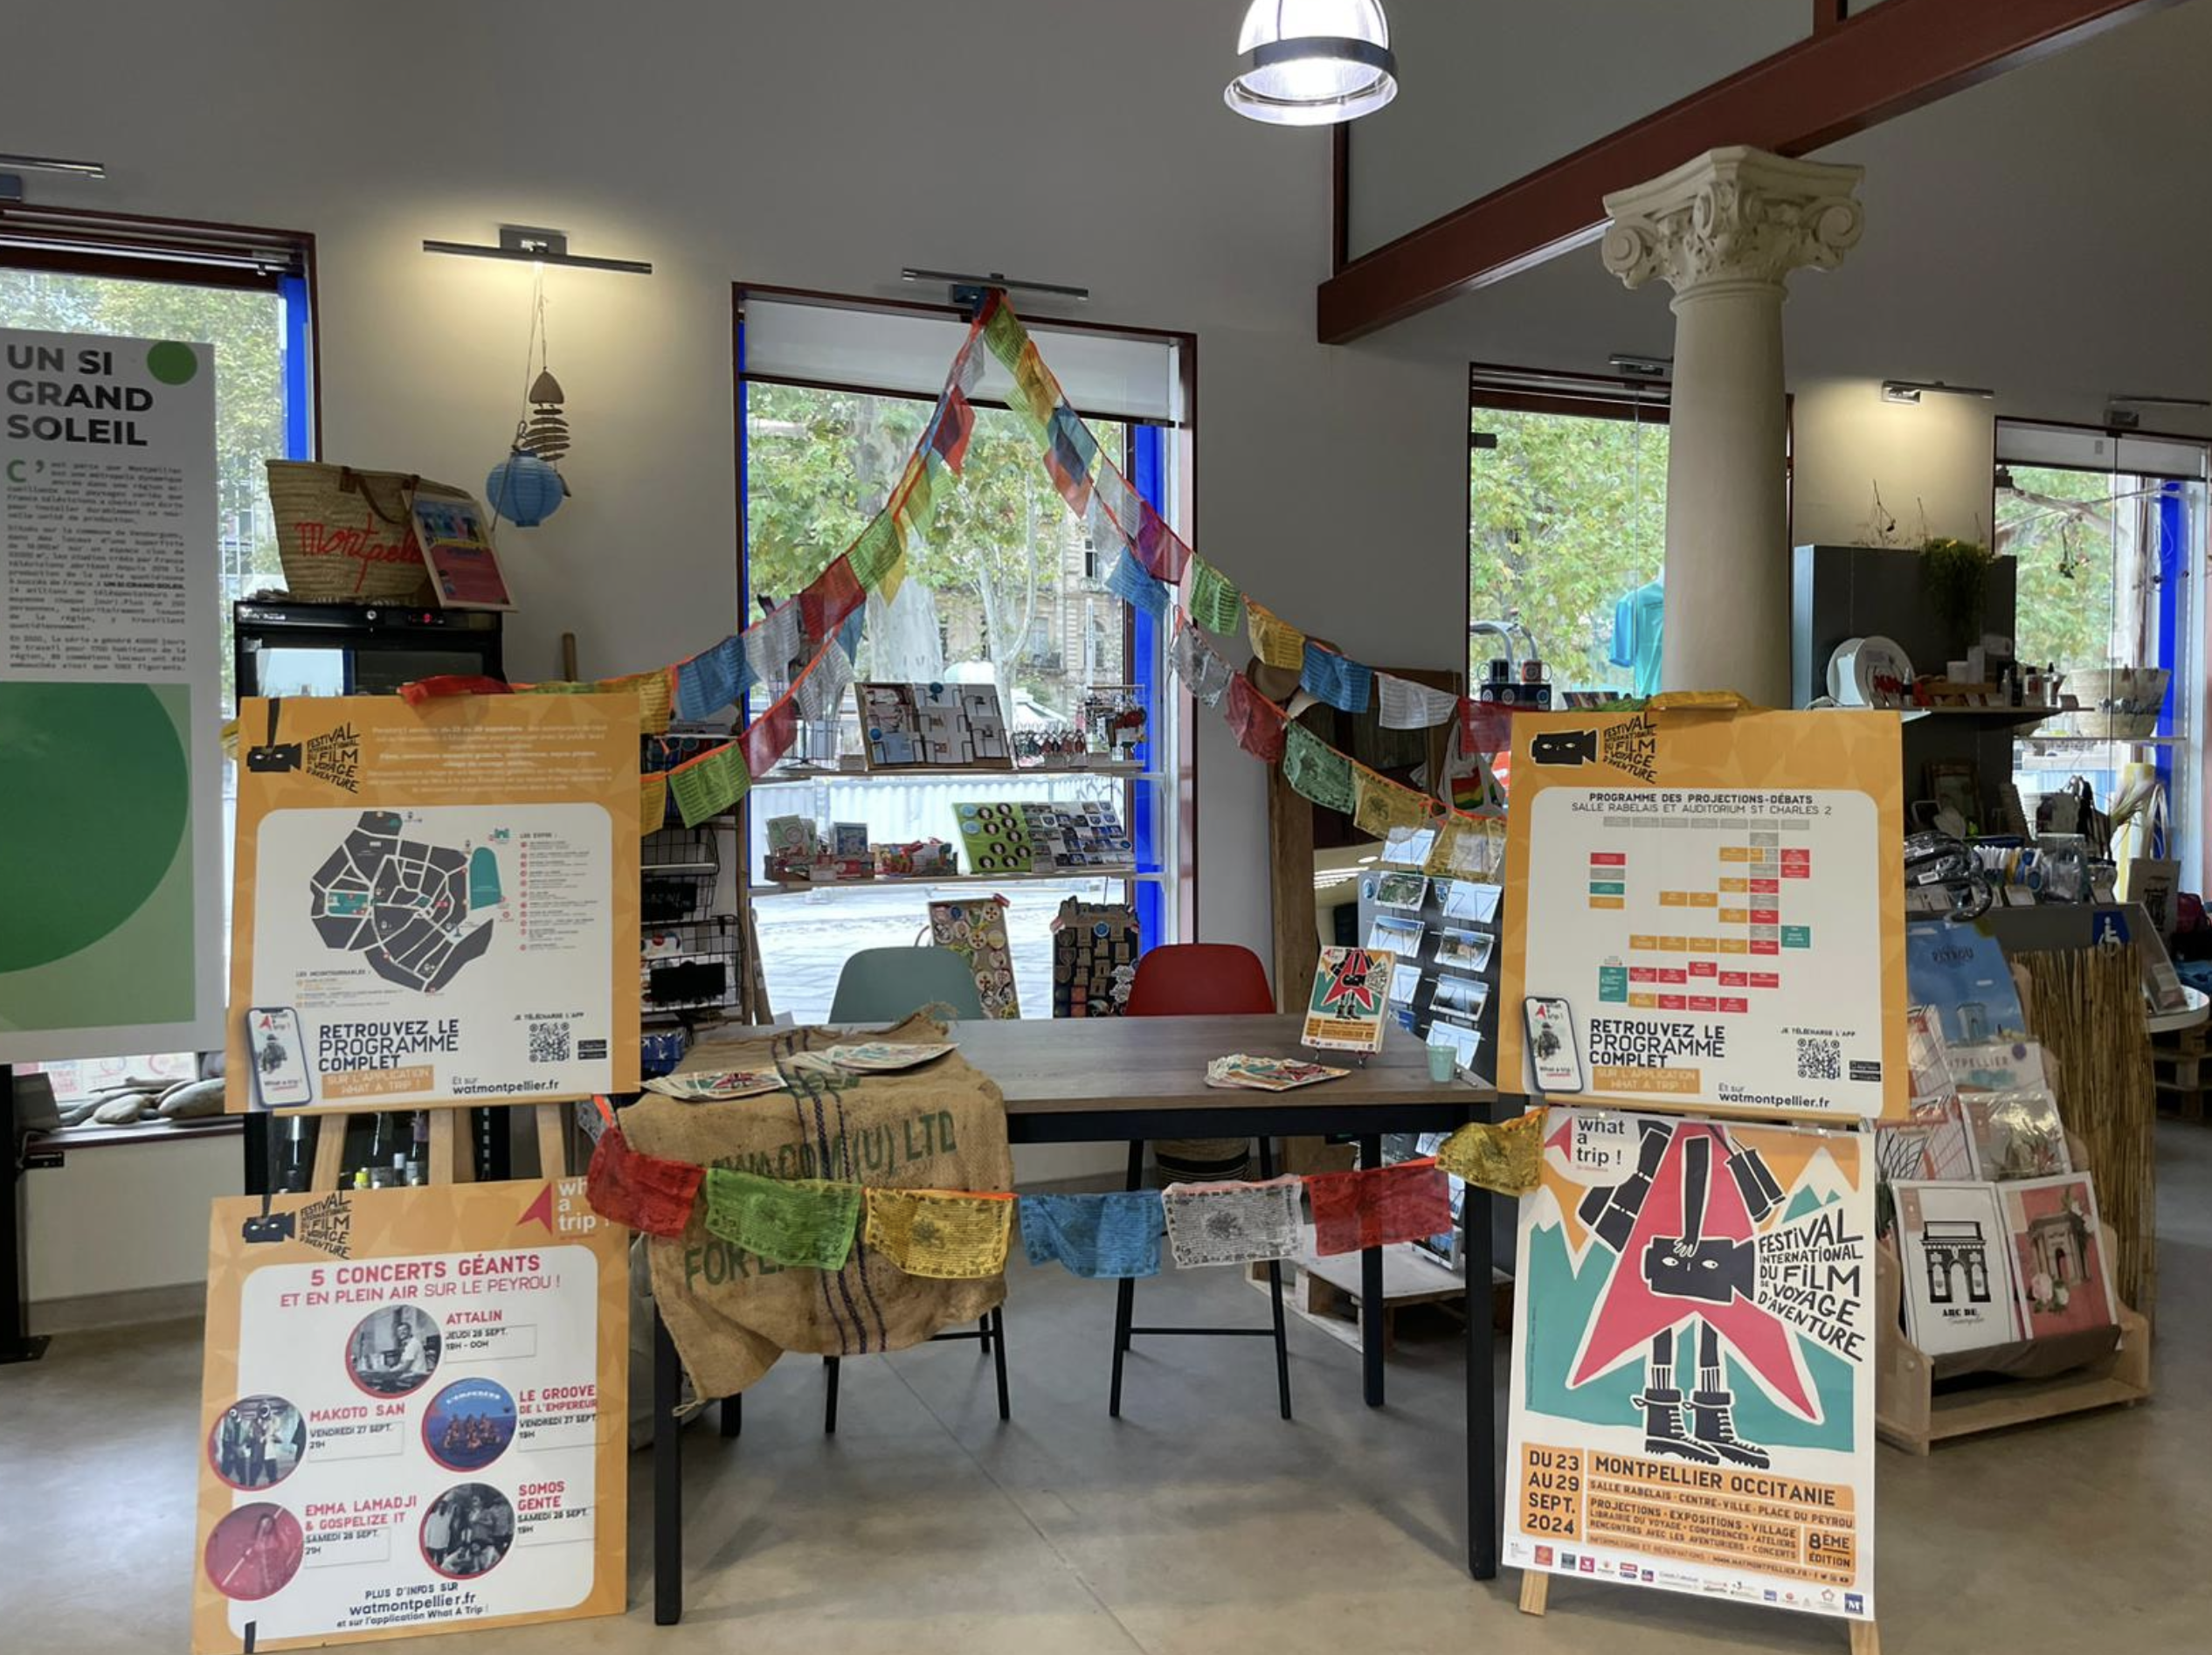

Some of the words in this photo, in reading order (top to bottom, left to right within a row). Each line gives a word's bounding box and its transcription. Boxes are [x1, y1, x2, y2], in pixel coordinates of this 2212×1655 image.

[7, 344, 64, 372] UN
[78, 350, 113, 376] SI
[6, 379, 154, 412] GRAND
[7, 414, 149, 447] SOLEIL
[1604, 711, 1658, 737] FESTIVAL
[308, 722, 361, 750] FESTIVAL
[1615, 738, 1656, 753] FILM
[320, 749, 358, 764] FILM
[1589, 793, 1656, 803] PROGRAMME
[1662, 793, 1682, 803] DES
[1571, 802, 1605, 811] SALLE
[1609, 803, 1658, 813] RABELAIS
[1663, 804, 1676, 813] ET
[1683, 803, 1745, 814] AUDITORIUM
[1751, 805, 1764, 814] ST
[1769, 805, 1820, 814] CHARLES
[1824, 807, 1832, 815] 2
[320, 1021, 428, 1039] RETROUVEZ
[439, 1019, 460, 1035] LE
[1590, 1019, 1695, 1039] RETROUVEZ
[1704, 1024, 1725, 1041] LE
[320, 1035, 460, 1056] PROGRAMME
[1590, 1034, 1725, 1058] PROGRAMME
[319, 1054, 401, 1072] COMPLET
[1589, 1050, 1669, 1069] COMPLET
[453, 1078, 560, 1095] watmontpellier.fr
[1718, 1092, 1832, 1108] watmontpellier.fr
[903, 1110, 958, 1162] LTD
[1578, 1117, 1626, 1135] what
[1577, 1132, 1587, 1145] a
[1576, 1147, 1609, 1167] trip
[301, 1189, 352, 1218] FESTIVAL
[559, 1198, 571, 1212] a
[313, 1215, 350, 1230] FILM
[559, 1212, 596, 1233] trip
[311, 1269, 325, 1287] 5
[335, 1261, 447, 1285] CONCERTS
[458, 1254, 541, 1277] GÉANTS
[1760, 1265, 1778, 1281] DU
[280, 1292, 301, 1308] ET
[307, 1291, 329, 1305] EN
[335, 1287, 384, 1304] PLEIN
[390, 1285, 418, 1301] AIR
[425, 1284, 457, 1298] SUR
[463, 1281, 483, 1295] LE
[487, 1276, 552, 1294] PEYROU
[1773, 1284, 1861, 1327] VOYAGE
[446, 1309, 503, 1326] ATTALIN
[1758, 1290, 1866, 1363] D'AVENTURE
[520, 1389, 536, 1402] LE
[543, 1384, 596, 1400] GROOVE
[309, 1405, 369, 1422] MAKOTO
[376, 1402, 406, 1417] SAN
[309, 1426, 356, 1438] VENDREDI
[1530, 1451, 1552, 1468] DU
[1556, 1454, 1580, 1471] 23
[518, 1480, 565, 1498] SOMOS
[1529, 1471, 1553, 1489] AU
[1556, 1474, 1580, 1492] 29
[1595, 1456, 1722, 1491] MONTPELLIER
[1731, 1476, 1836, 1506] OCCITANIE
[305, 1503, 347, 1516] EMMA
[354, 1496, 418, 1513] LAMADJI
[517, 1494, 562, 1512] GENTE
[1529, 1492, 1576, 1514] SEPT.
[1590, 1480, 1621, 1493] SALLE
[1623, 1485, 1672, 1501] RABELAIS
[1758, 1504, 1791, 1519] PLACE
[1794, 1511, 1808, 1522] DU
[1811, 1513, 1854, 1529] PEYROU
[320, 1513, 389, 1530] GOSPELIZE
[394, 1512, 406, 1523] IT
[1526, 1513, 1575, 1535] 2024
[1590, 1498, 1662, 1517] PROJECTIONS
[1669, 1510, 1743, 1531] EXPOSITIONS
[1752, 1522, 1798, 1540] VILLAGE
[305, 1533, 342, 1544] SAMEDI
[1590, 1510, 1631, 1523] LIBRAIRIE
[1633, 1515, 1646, 1525] DU
[1648, 1518, 1682, 1531] VOYAGE
[1755, 1535, 1798, 1550] ATELIERS
[1590, 1520, 1642, 1535] RENCONTRES
[1669, 1531, 1685, 1541] LES
[1752, 1544, 1798, 1560] CONCERTS
[1808, 1552, 1850, 1568] ÉDITION
[364, 1588, 391, 1601] PLUS
[396, 1583, 435, 1597] D'INFOS
[439, 1582, 460, 1592] SUR
[349, 1591, 478, 1617] watmontpellier.fr
[336, 1619, 347, 1628] et
[349, 1618, 364, 1628] sur
[365, 1612, 426, 1626] l'application
[427, 1609, 453, 1619] What
[455, 1606, 463, 1616] A
[465, 1604, 484, 1616] Trip
